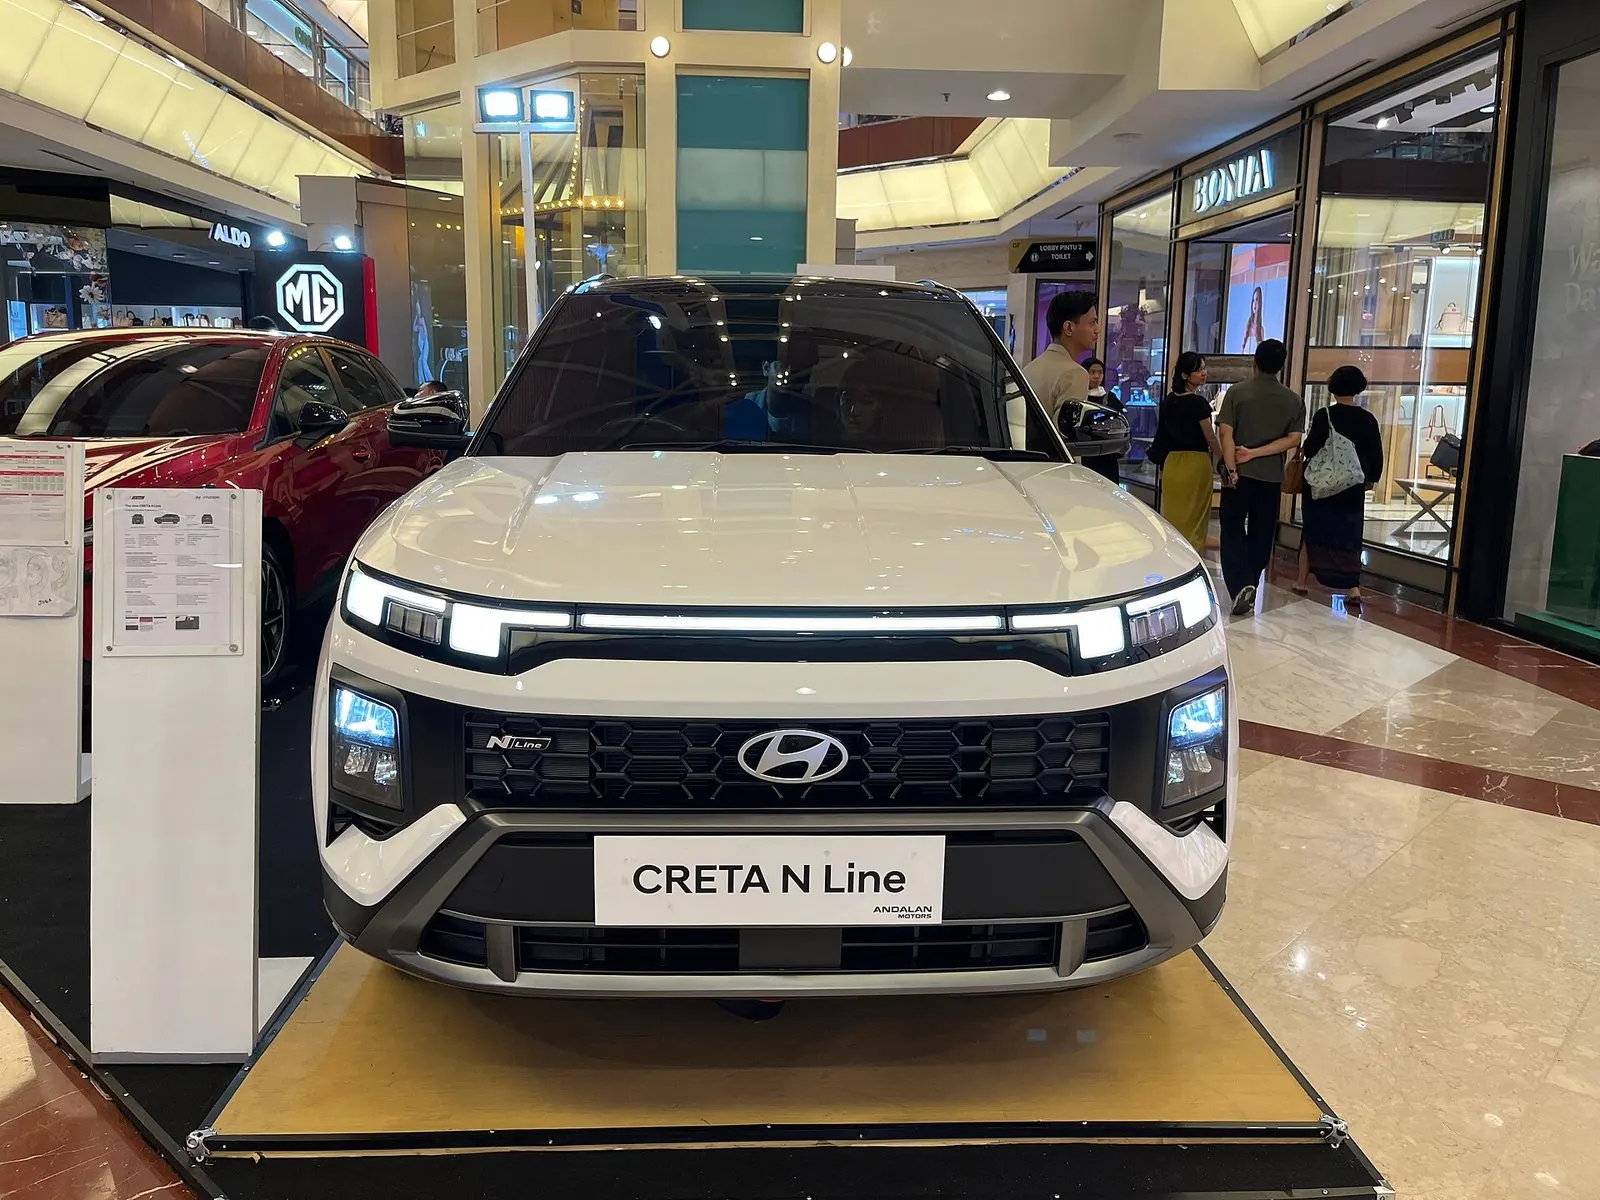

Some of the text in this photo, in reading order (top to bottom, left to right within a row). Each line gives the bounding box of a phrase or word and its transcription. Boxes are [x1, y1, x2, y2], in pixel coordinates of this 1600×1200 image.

[1193, 149, 1276, 213] BONIA
[213, 223, 251, 249] ALDO
[1039, 244, 1059, 252] LOBBY
[285, 273, 335, 323] MG
[486, 735, 542, 749] N Line
[632, 862, 906, 894] CRETA N Line
